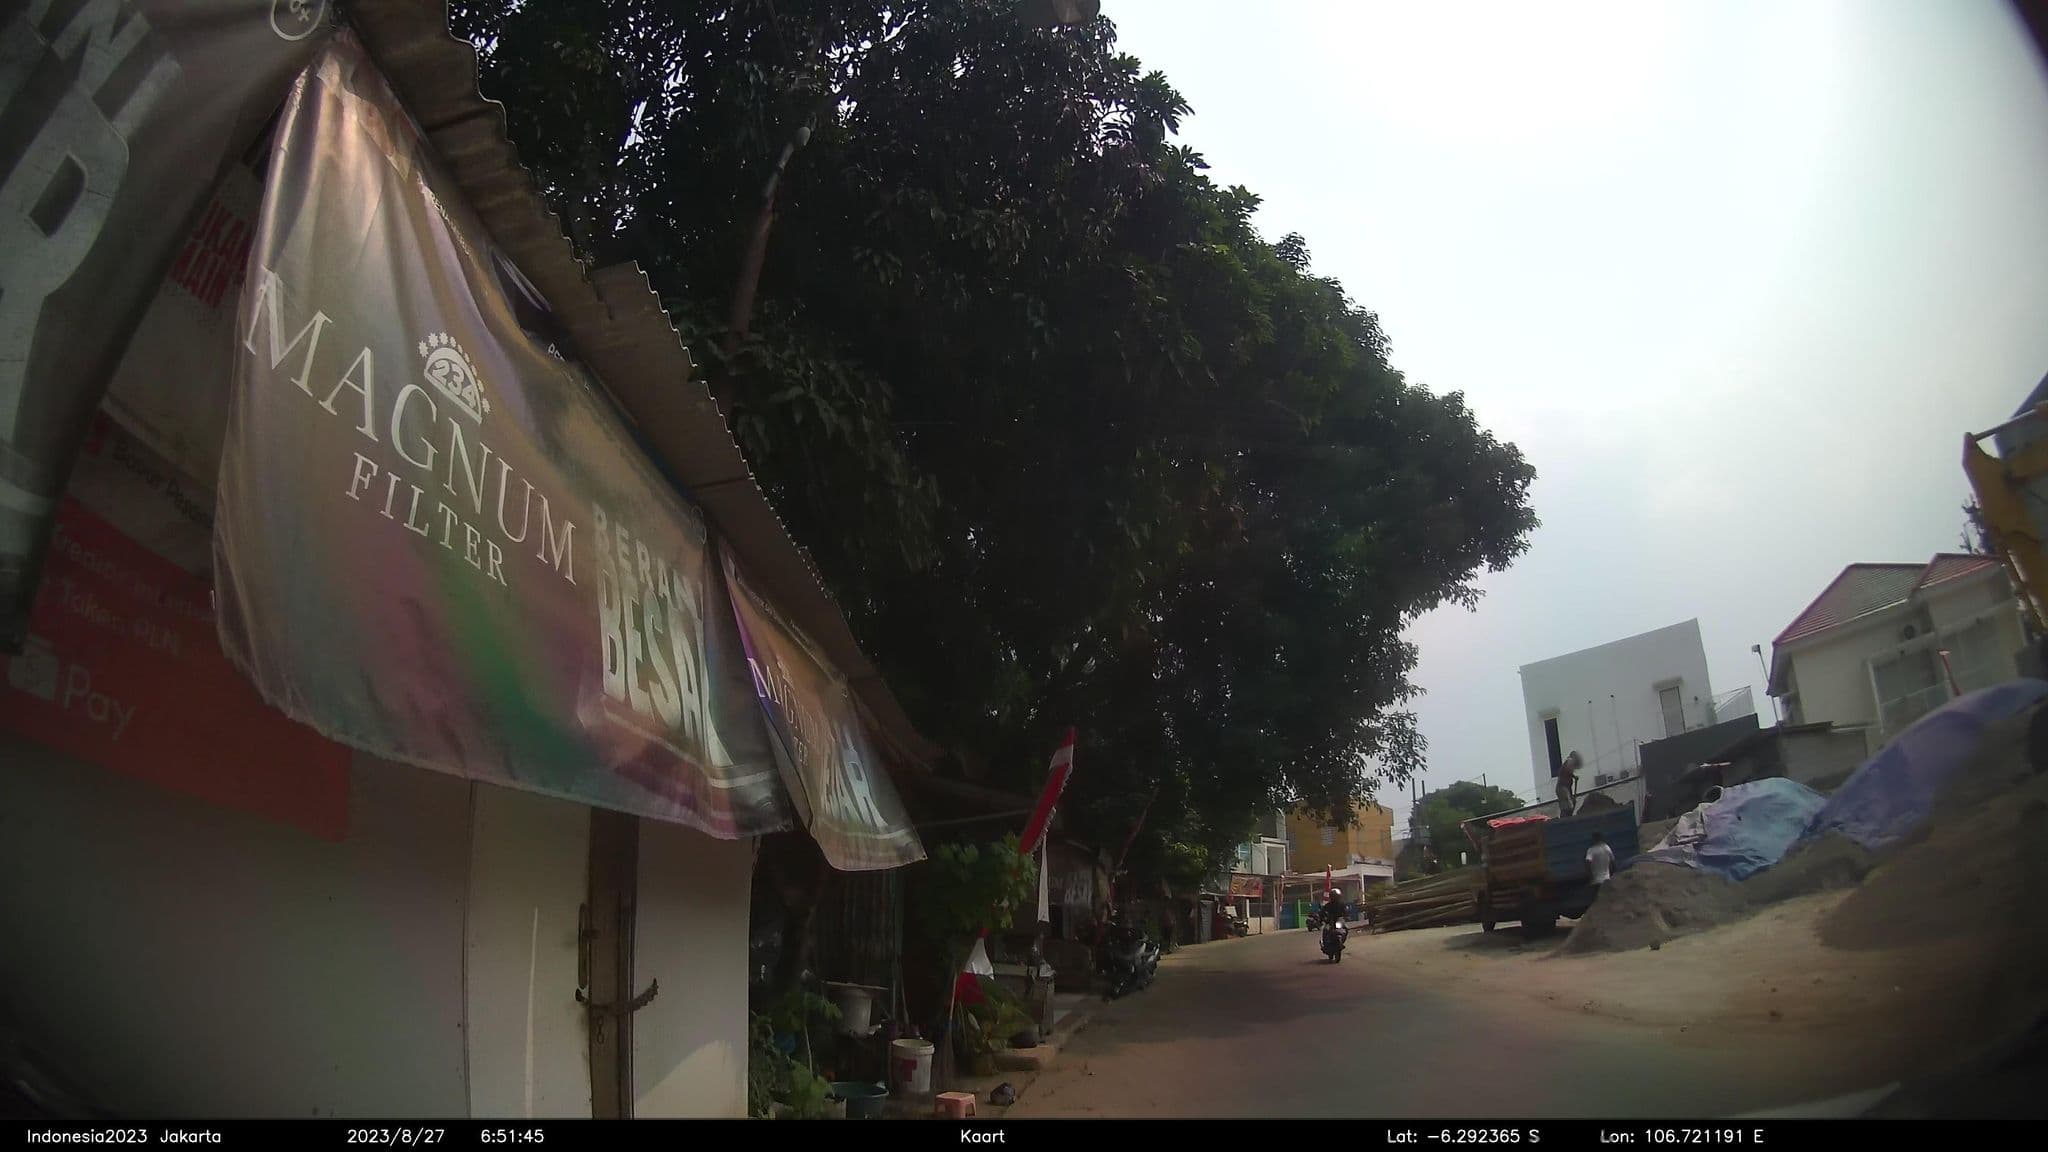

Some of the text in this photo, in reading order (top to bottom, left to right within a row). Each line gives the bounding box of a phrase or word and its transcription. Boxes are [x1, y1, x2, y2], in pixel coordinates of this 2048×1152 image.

[242, 264, 577, 586] MAGNUM
[430, 358, 477, 410] 234
[344, 451, 508, 587] FILTER
[62, 662, 137, 741] Pay
